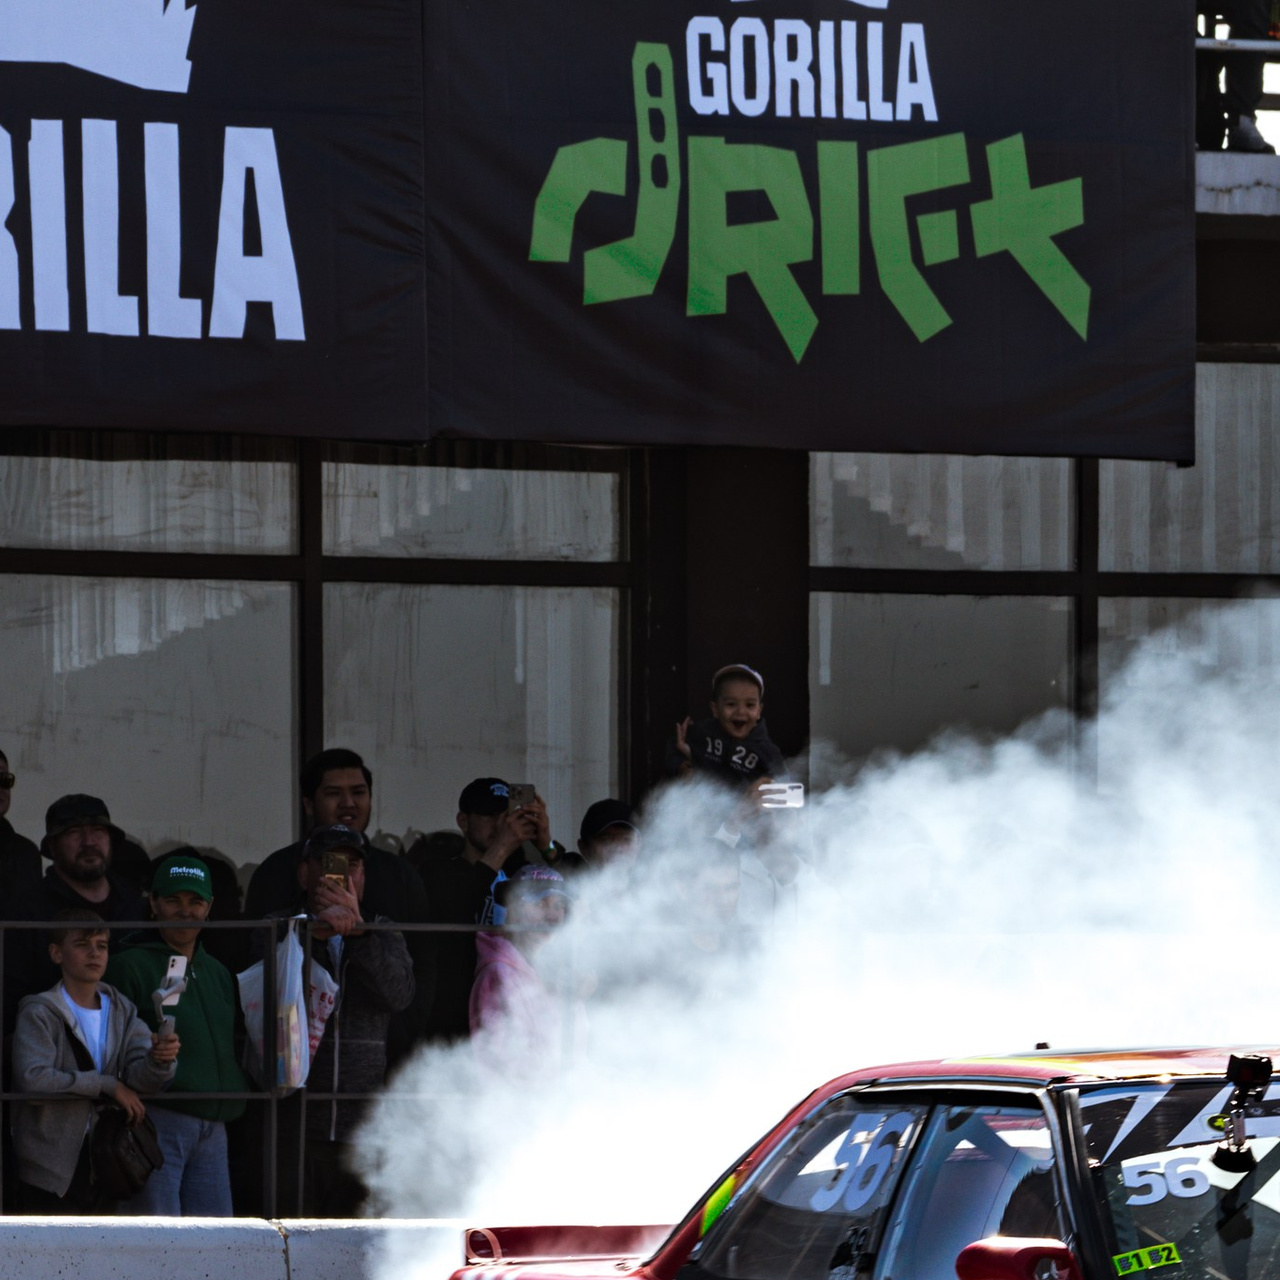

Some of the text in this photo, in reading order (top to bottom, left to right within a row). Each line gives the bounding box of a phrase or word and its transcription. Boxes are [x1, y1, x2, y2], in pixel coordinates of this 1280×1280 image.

[686, 15, 938, 122] GORILLA
[705, 736, 723, 756] 19
[809, 1111, 915, 1212] 56
[1121, 1156, 1211, 1206] 56
